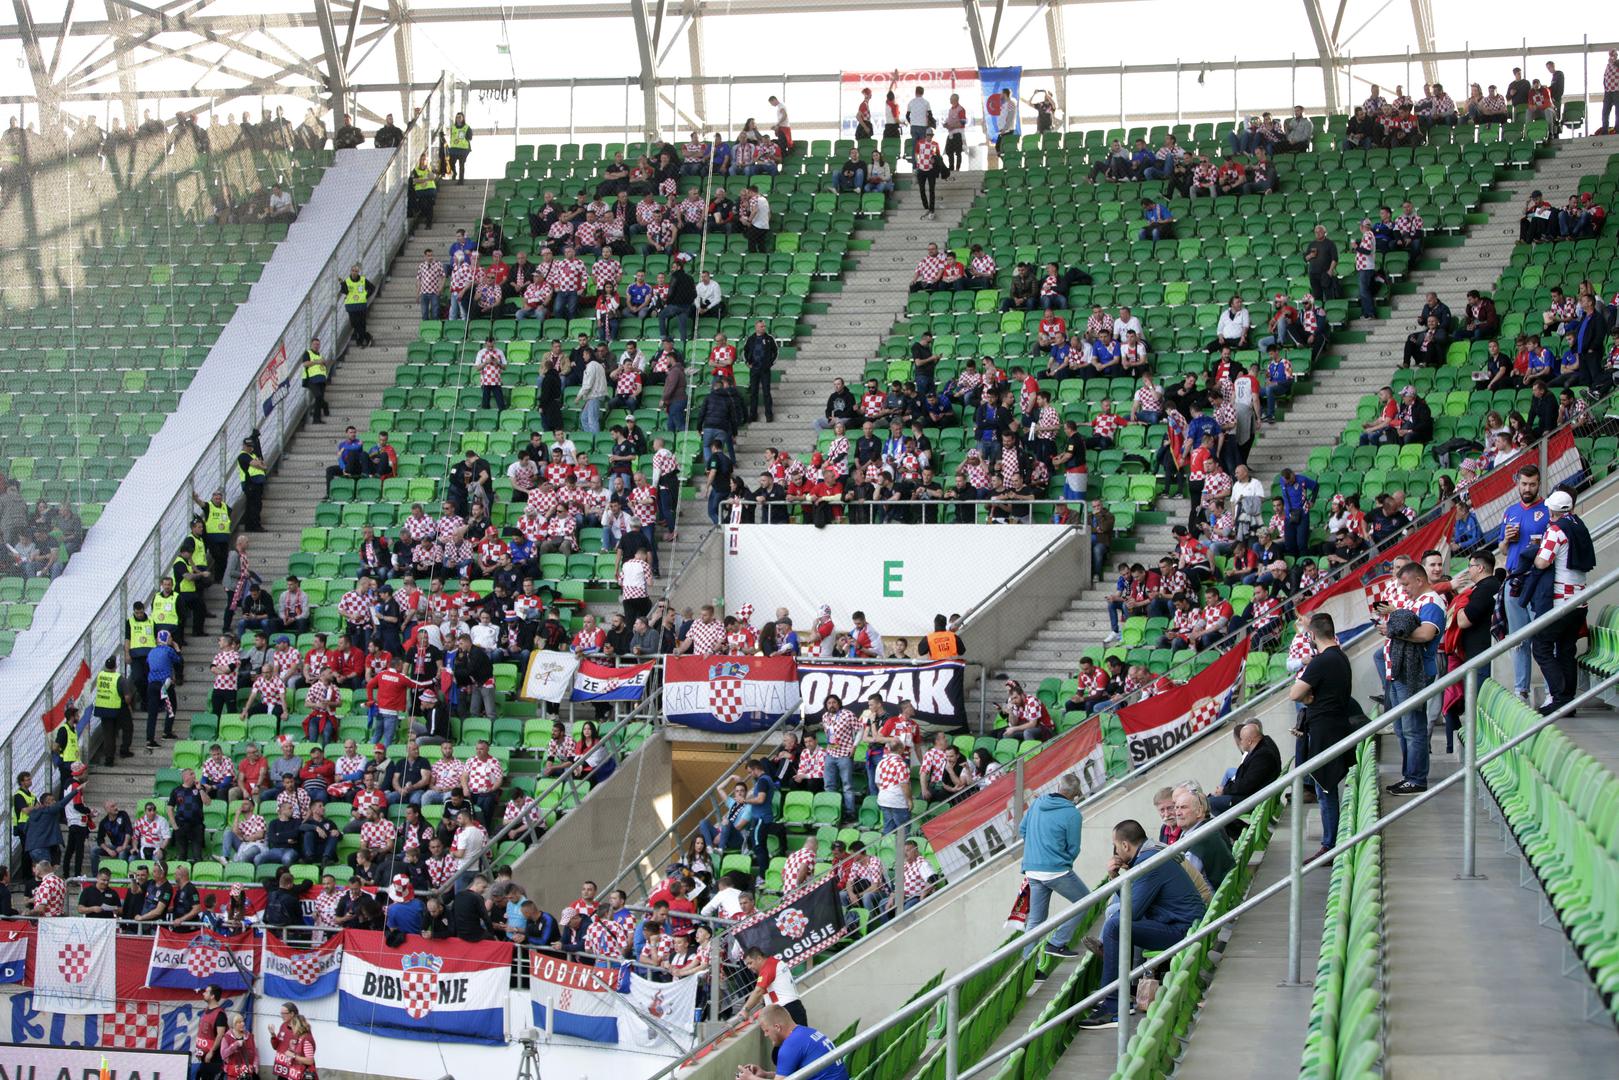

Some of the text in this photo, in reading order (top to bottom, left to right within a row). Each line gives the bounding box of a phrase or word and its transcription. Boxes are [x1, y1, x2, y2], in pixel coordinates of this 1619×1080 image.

[883, 560, 904, 598] E
[800, 669, 955, 716] ODŽAK
[1129, 721, 1193, 762] ŠIROKI
[438, 979, 469, 1004] NJE
